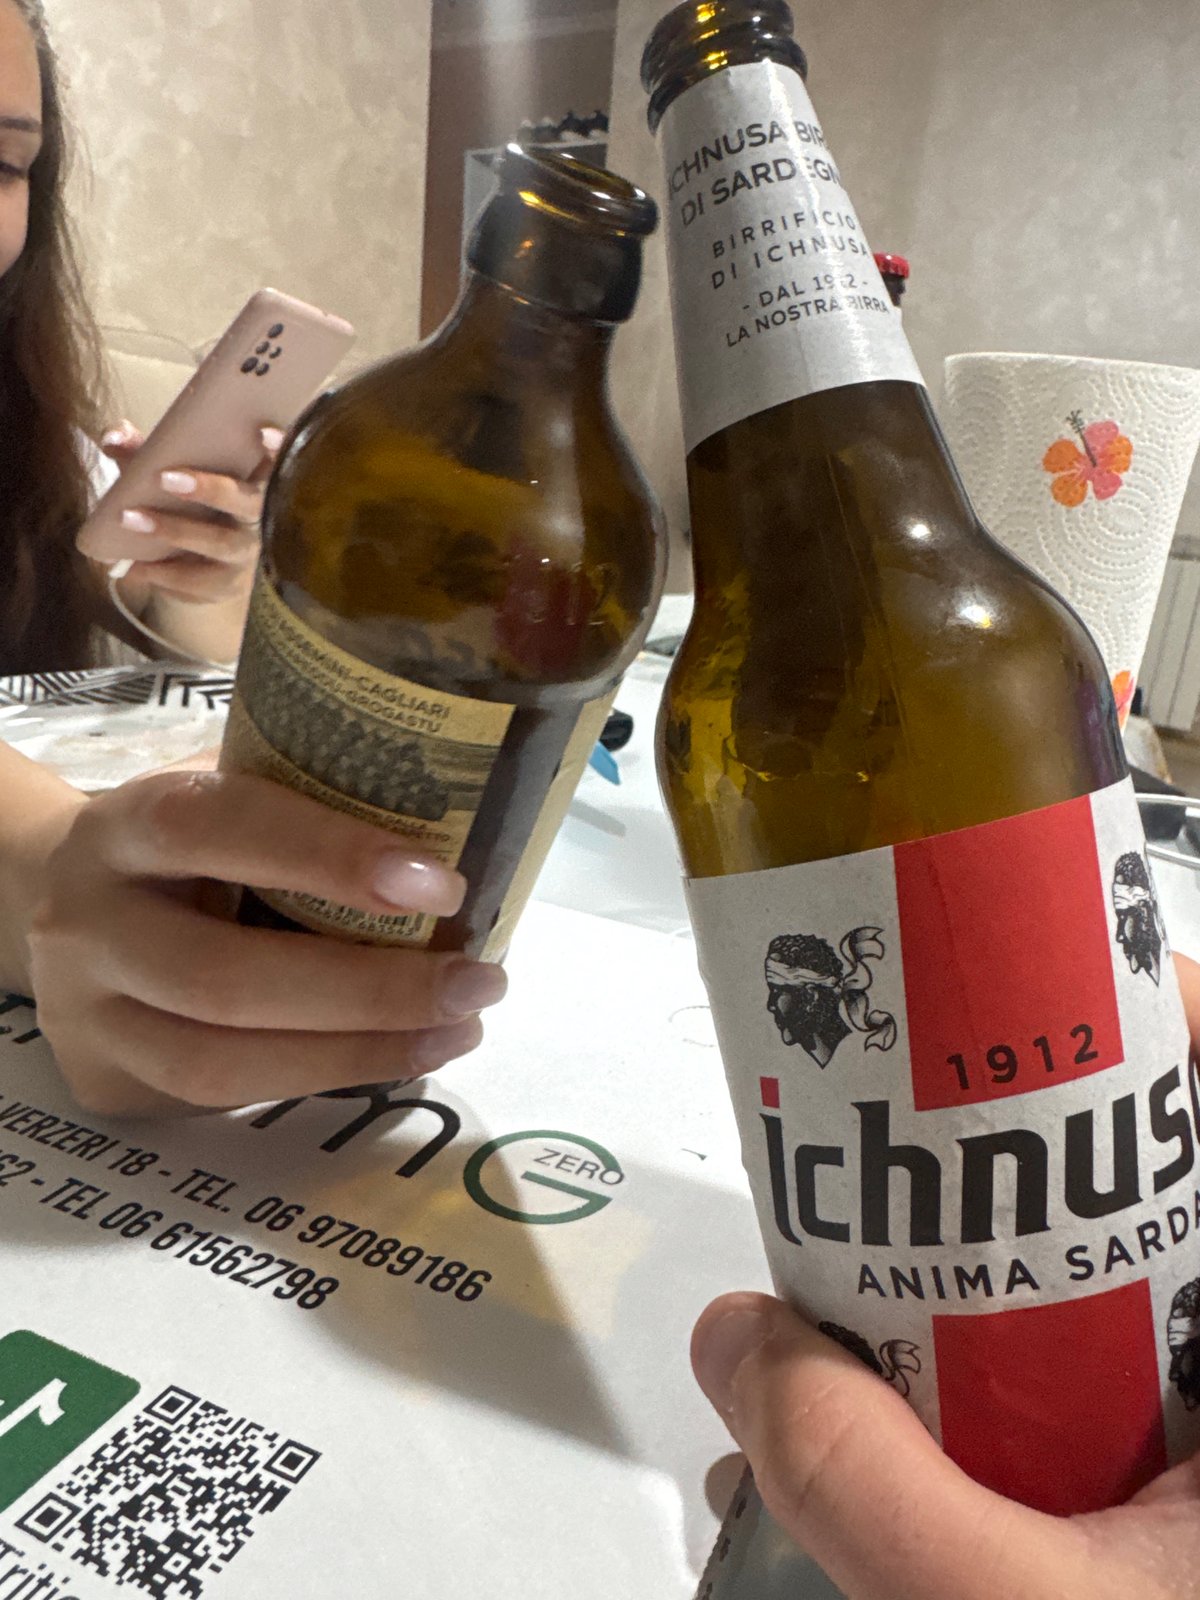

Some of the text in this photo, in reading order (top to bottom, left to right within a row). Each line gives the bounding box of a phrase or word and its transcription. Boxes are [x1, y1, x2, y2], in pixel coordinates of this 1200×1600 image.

[681, 191, 704, 227] DI
[712, 211, 856, 258] BIRRIFICIO
[712, 262, 737, 290] DI
[759, 281, 804, 307] DAL
[726, 325, 750, 347] LA
[755, 297, 841, 333] NOSTRA
[946, 1023, 1099, 1091] 1912
[533, 1147, 625, 1186] ZERO
[0, 1102, 121, 1161] VERZERI
[107, 1147, 160, 1176] 18
[170, 1168, 237, 1213] TEL.
[244, 1196, 305, 1232] 06
[297, 1214, 493, 1302] 97089186
[39, 1177, 111, 1220] TEL
[99, 1202, 164, 1238] 06
[150, 1221, 340, 1310] 61562798
[857, 1258, 1041, 1300] ANIMA
